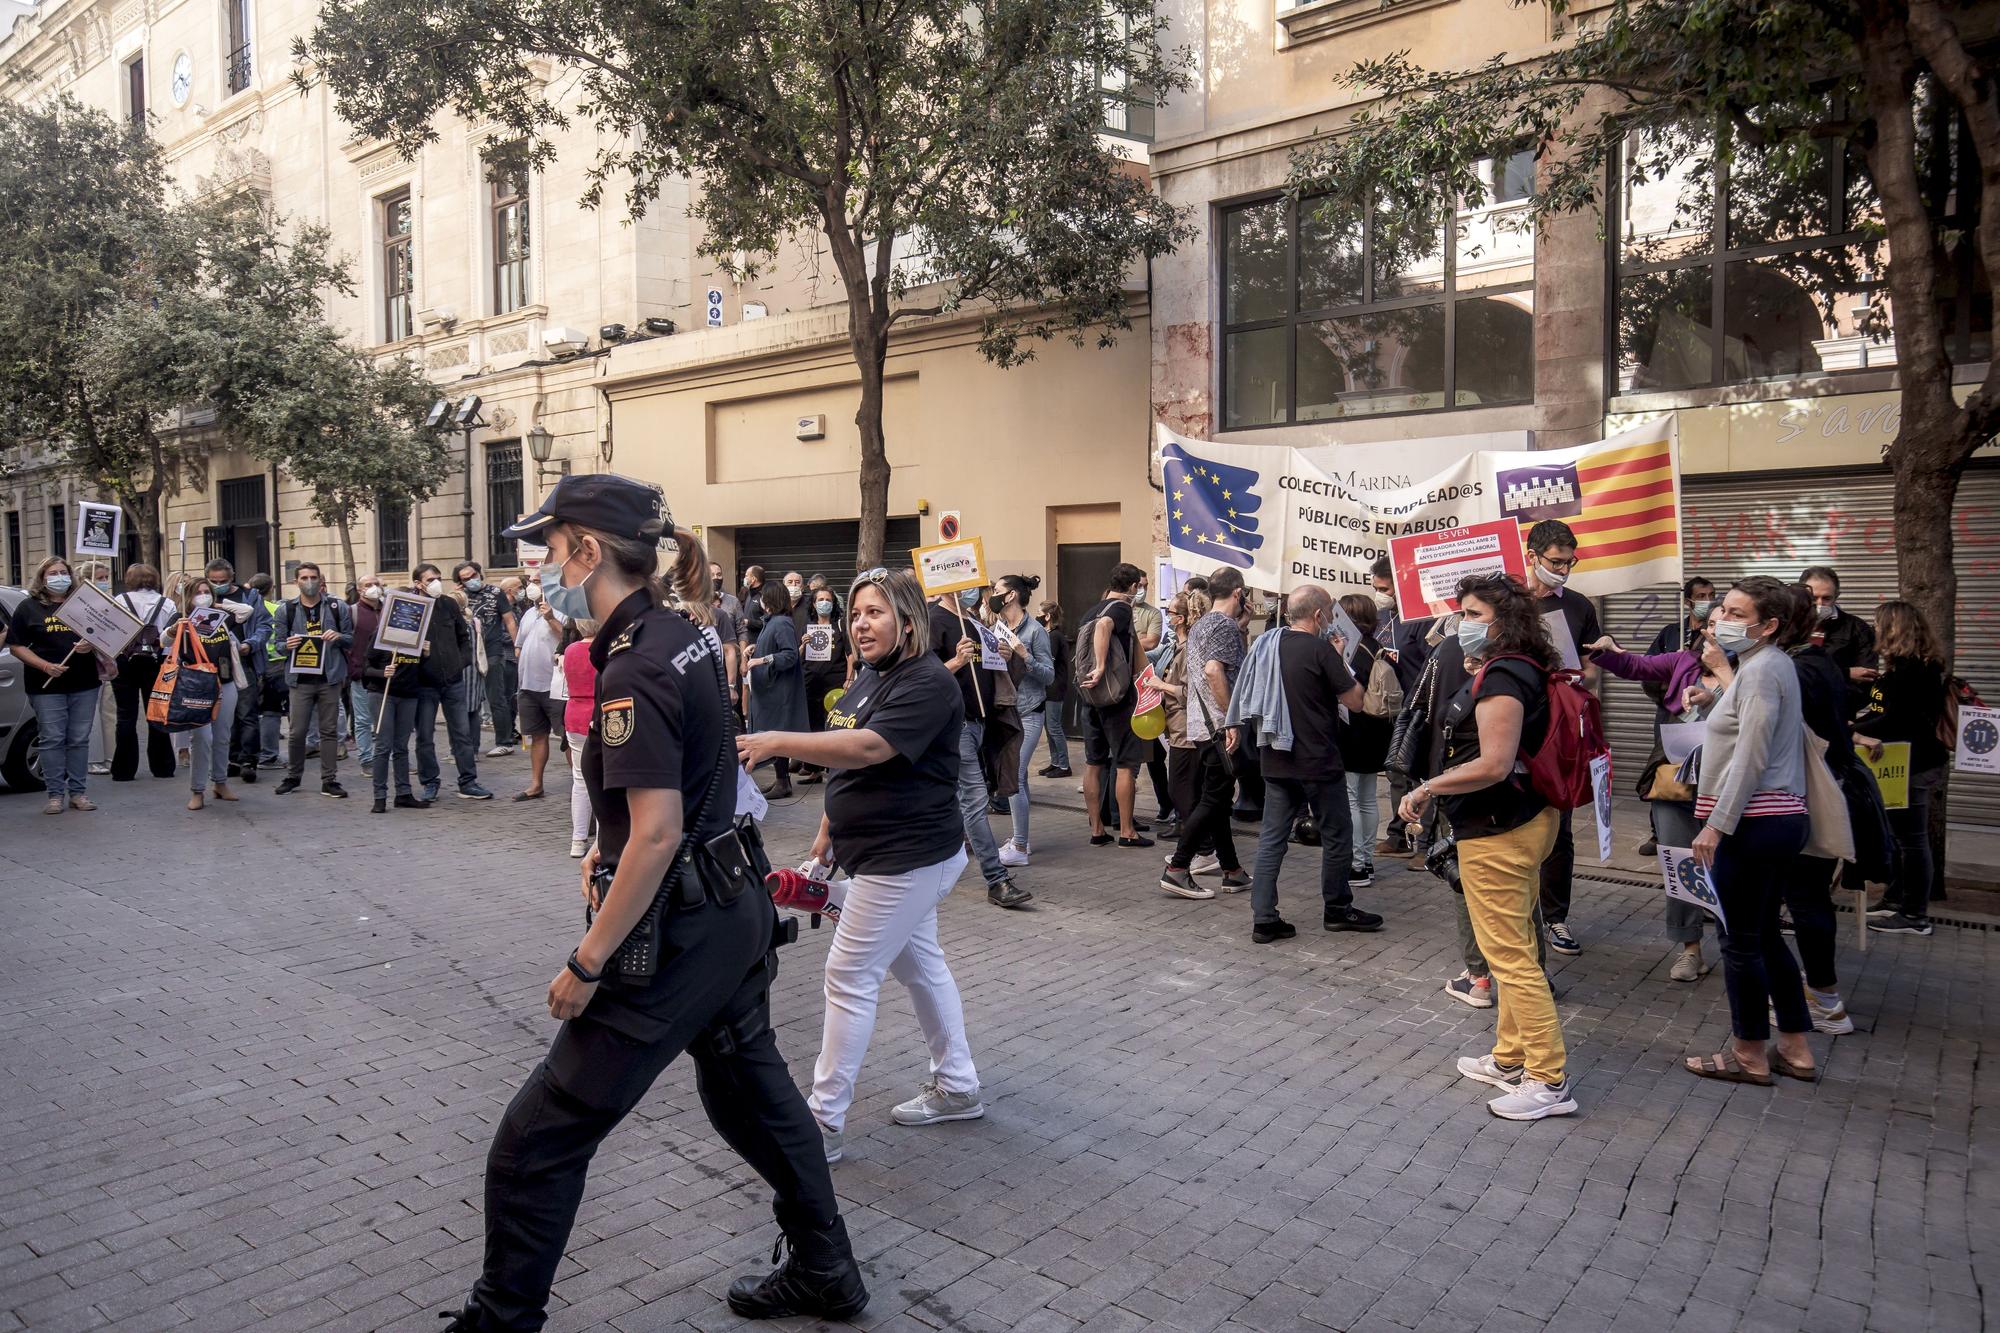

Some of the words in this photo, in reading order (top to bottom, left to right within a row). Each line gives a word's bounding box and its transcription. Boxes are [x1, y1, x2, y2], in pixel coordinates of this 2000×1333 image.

[1383, 482, 1483, 515] EMPLEAD@S
[1299, 506, 1370, 533] PÚBLIC@S
[1375, 522, 1397, 536] EN
[1401, 515, 1460, 536] ABUSO
[1438, 531, 1449, 540] ES
[1451, 527, 1470, 538] VEN
[1302, 535, 1318, 551] DE
[1416, 543, 1456, 553] TEBALLADORA
[1292, 561, 1309, 576] DE
[1312, 565, 1336, 582] LES
